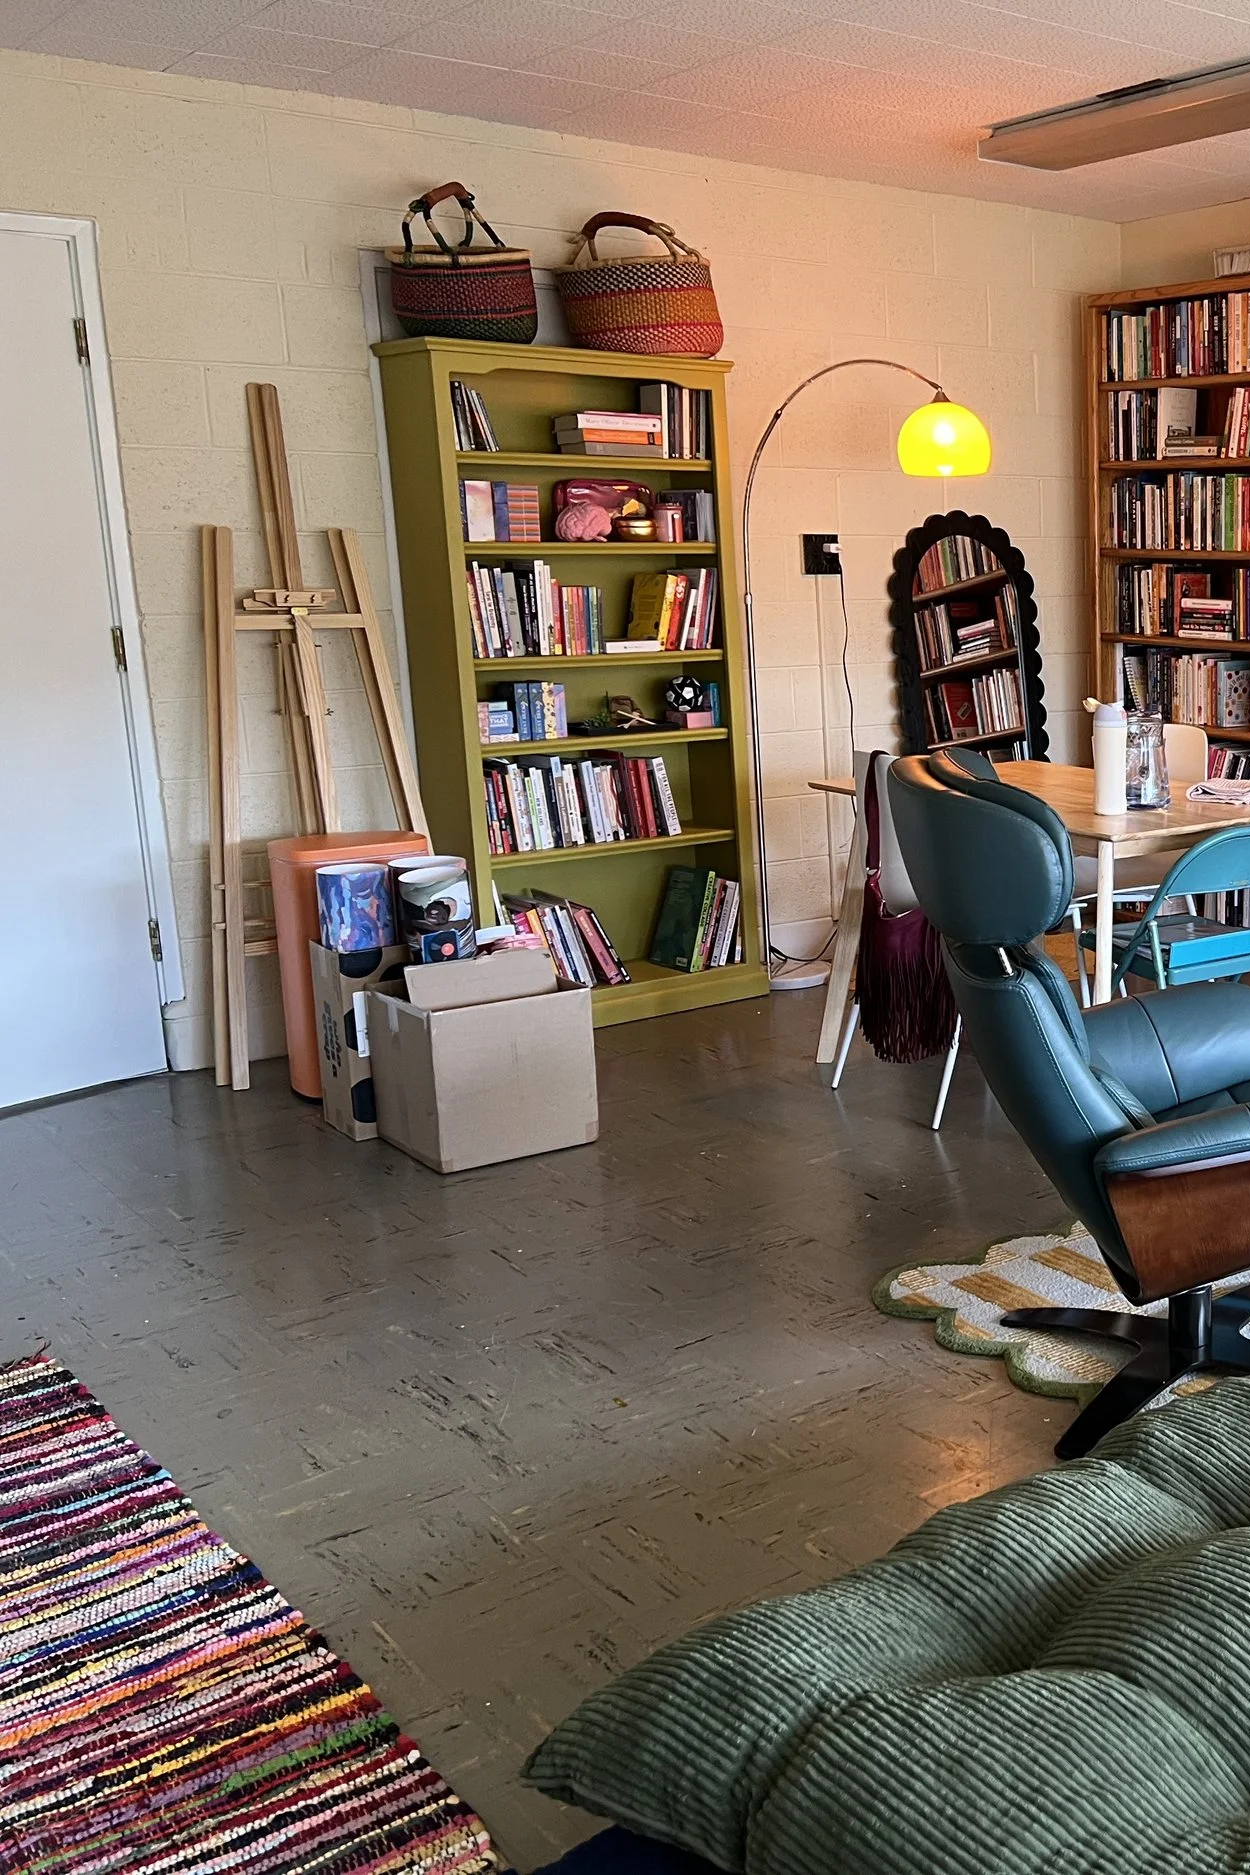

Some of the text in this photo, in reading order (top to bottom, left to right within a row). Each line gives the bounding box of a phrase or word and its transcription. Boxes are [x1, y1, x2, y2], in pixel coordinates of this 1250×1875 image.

[674, 577, 687, 599] 365
[669, 803, 677, 820] PEOPLE
[700, 877, 714, 927] CREATIVE COLLAGE
